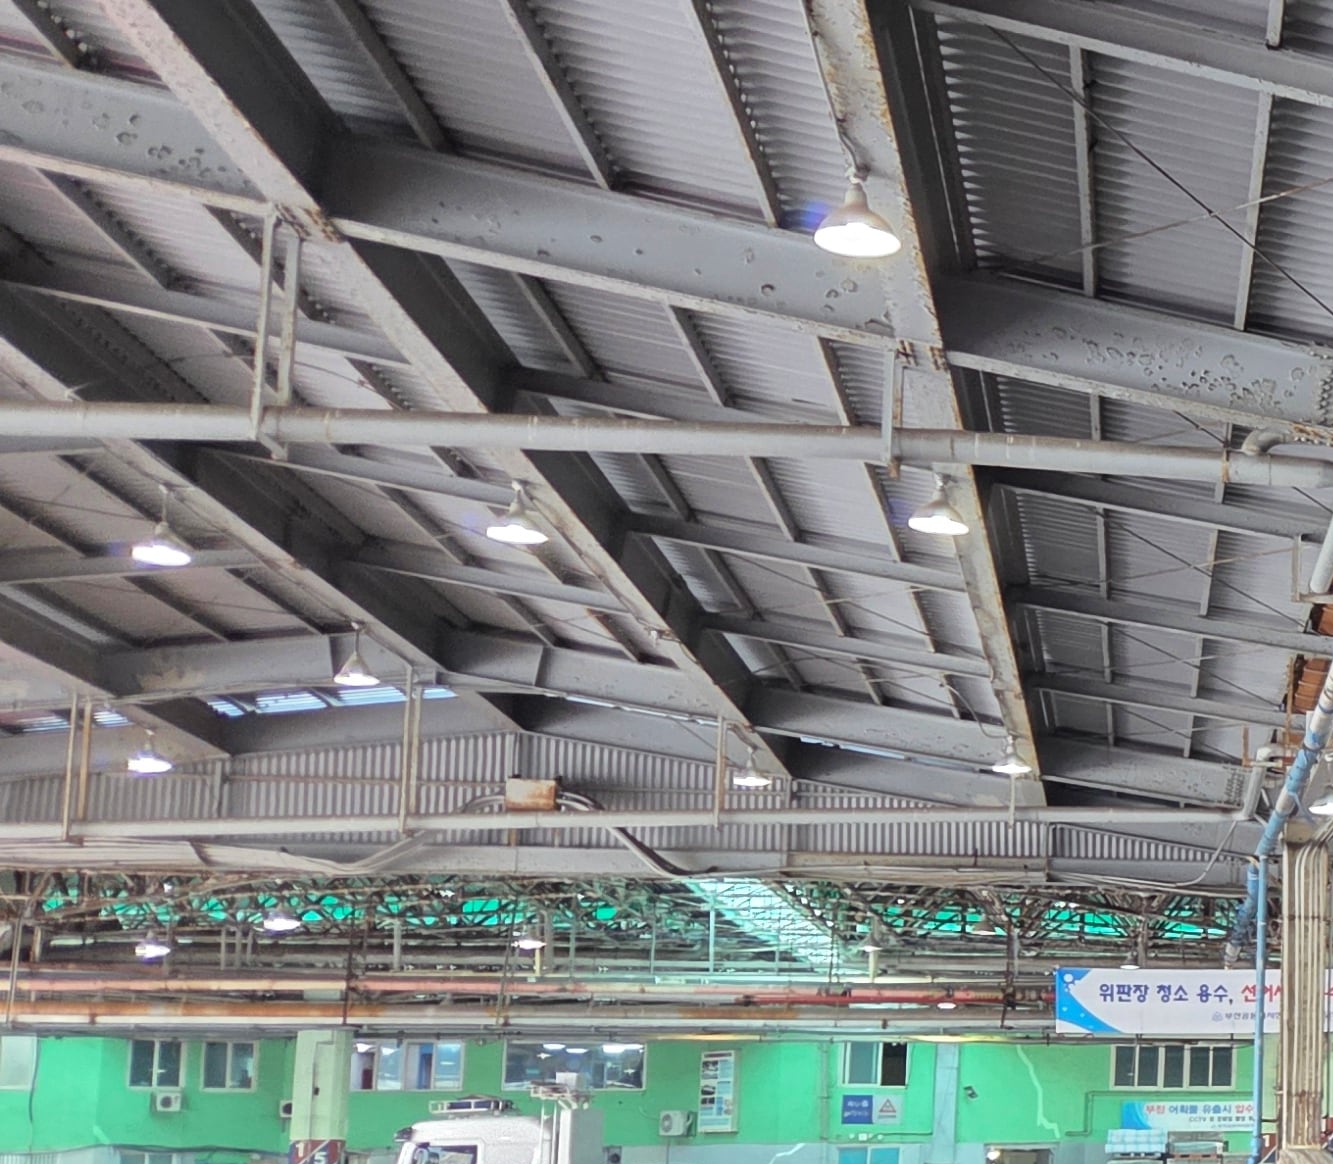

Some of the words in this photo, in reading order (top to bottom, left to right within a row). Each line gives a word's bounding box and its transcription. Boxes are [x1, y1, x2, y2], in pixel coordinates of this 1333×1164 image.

[1098, 983, 1149, 1003] 위판장
[1156, 983, 1189, 1003] 청소
[1262, 1135, 1270, 1147] 1
[296, 1142, 304, 1158] 1
